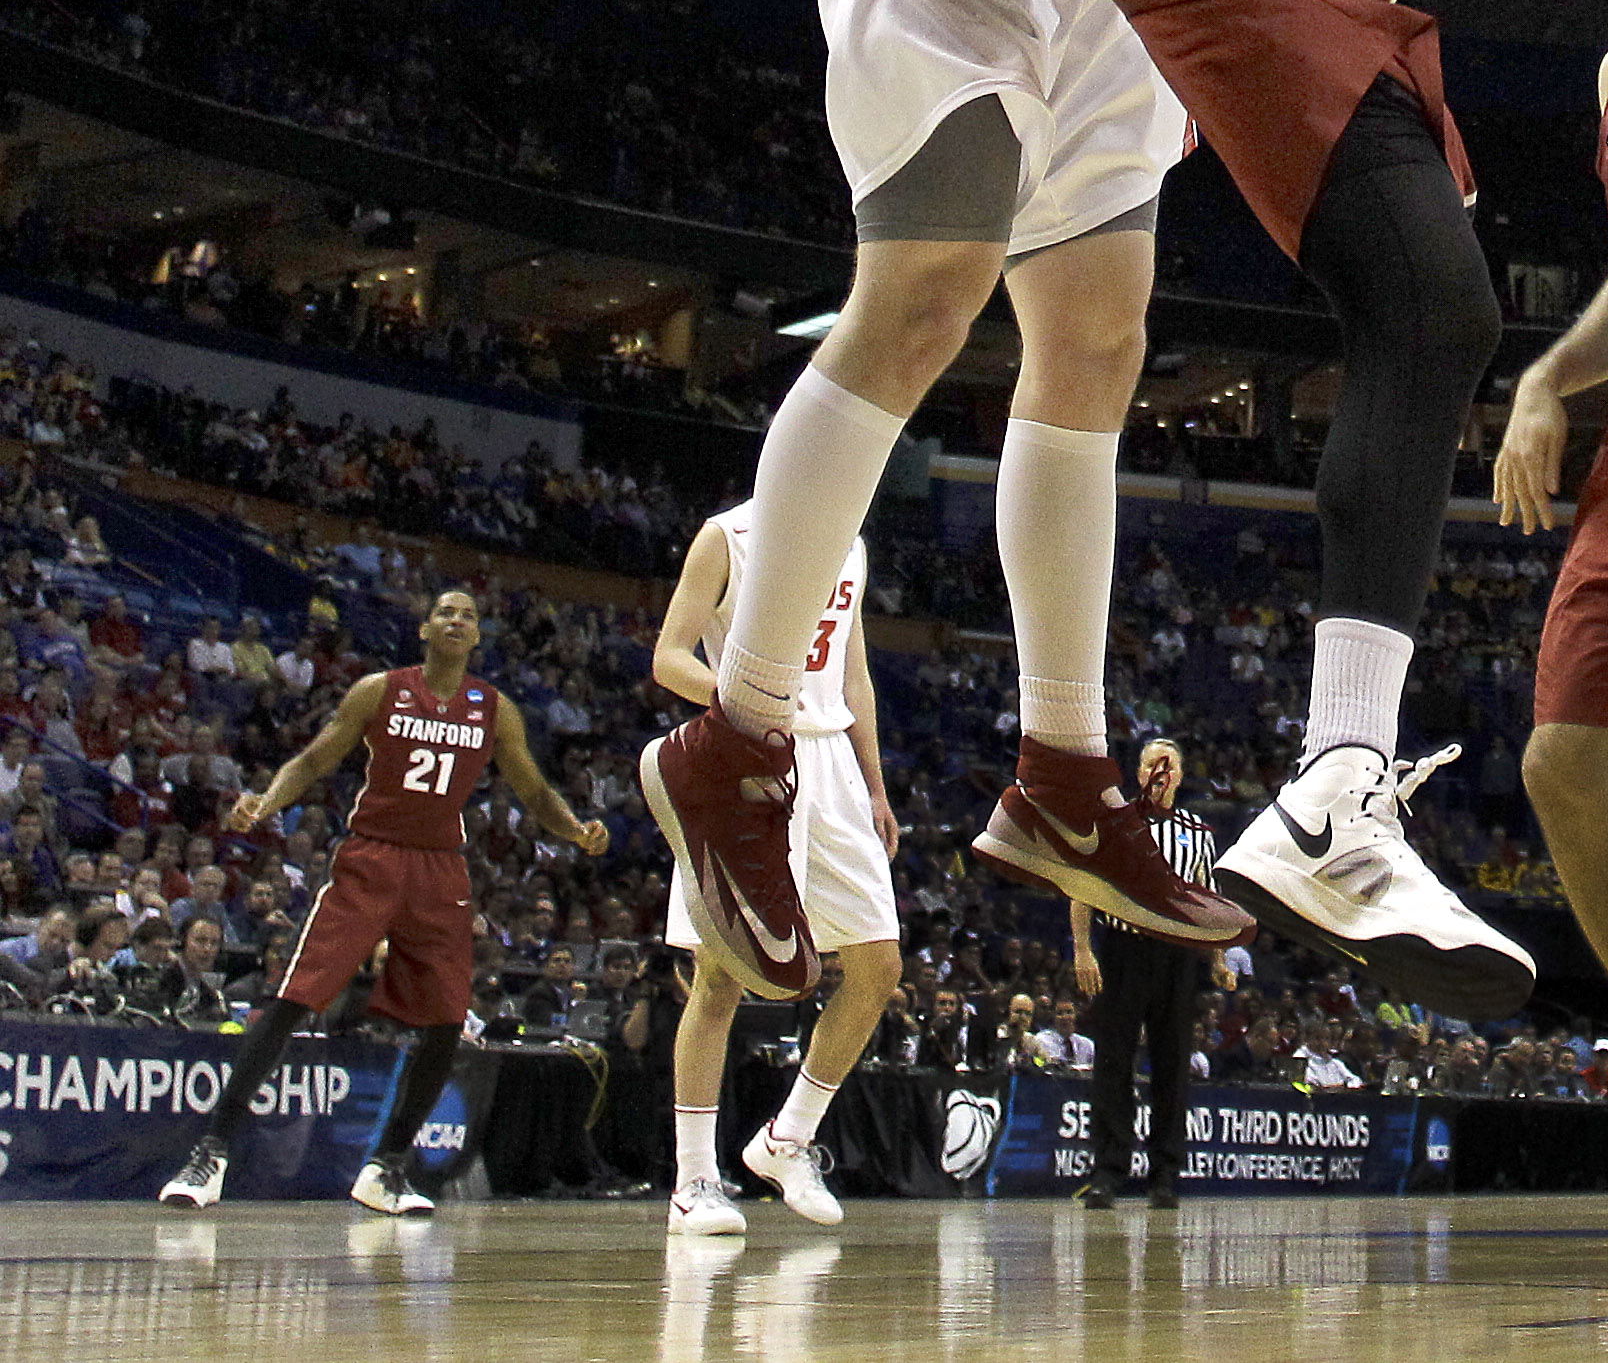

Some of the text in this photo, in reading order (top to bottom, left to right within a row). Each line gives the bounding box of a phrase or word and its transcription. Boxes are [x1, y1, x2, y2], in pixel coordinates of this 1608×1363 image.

[386, 713, 485, 750] STANFORD
[402, 748, 456, 796] 21
[1219, 1108, 1283, 1145] THIRD
[1287, 1111, 1370, 1148] ROUNDS
